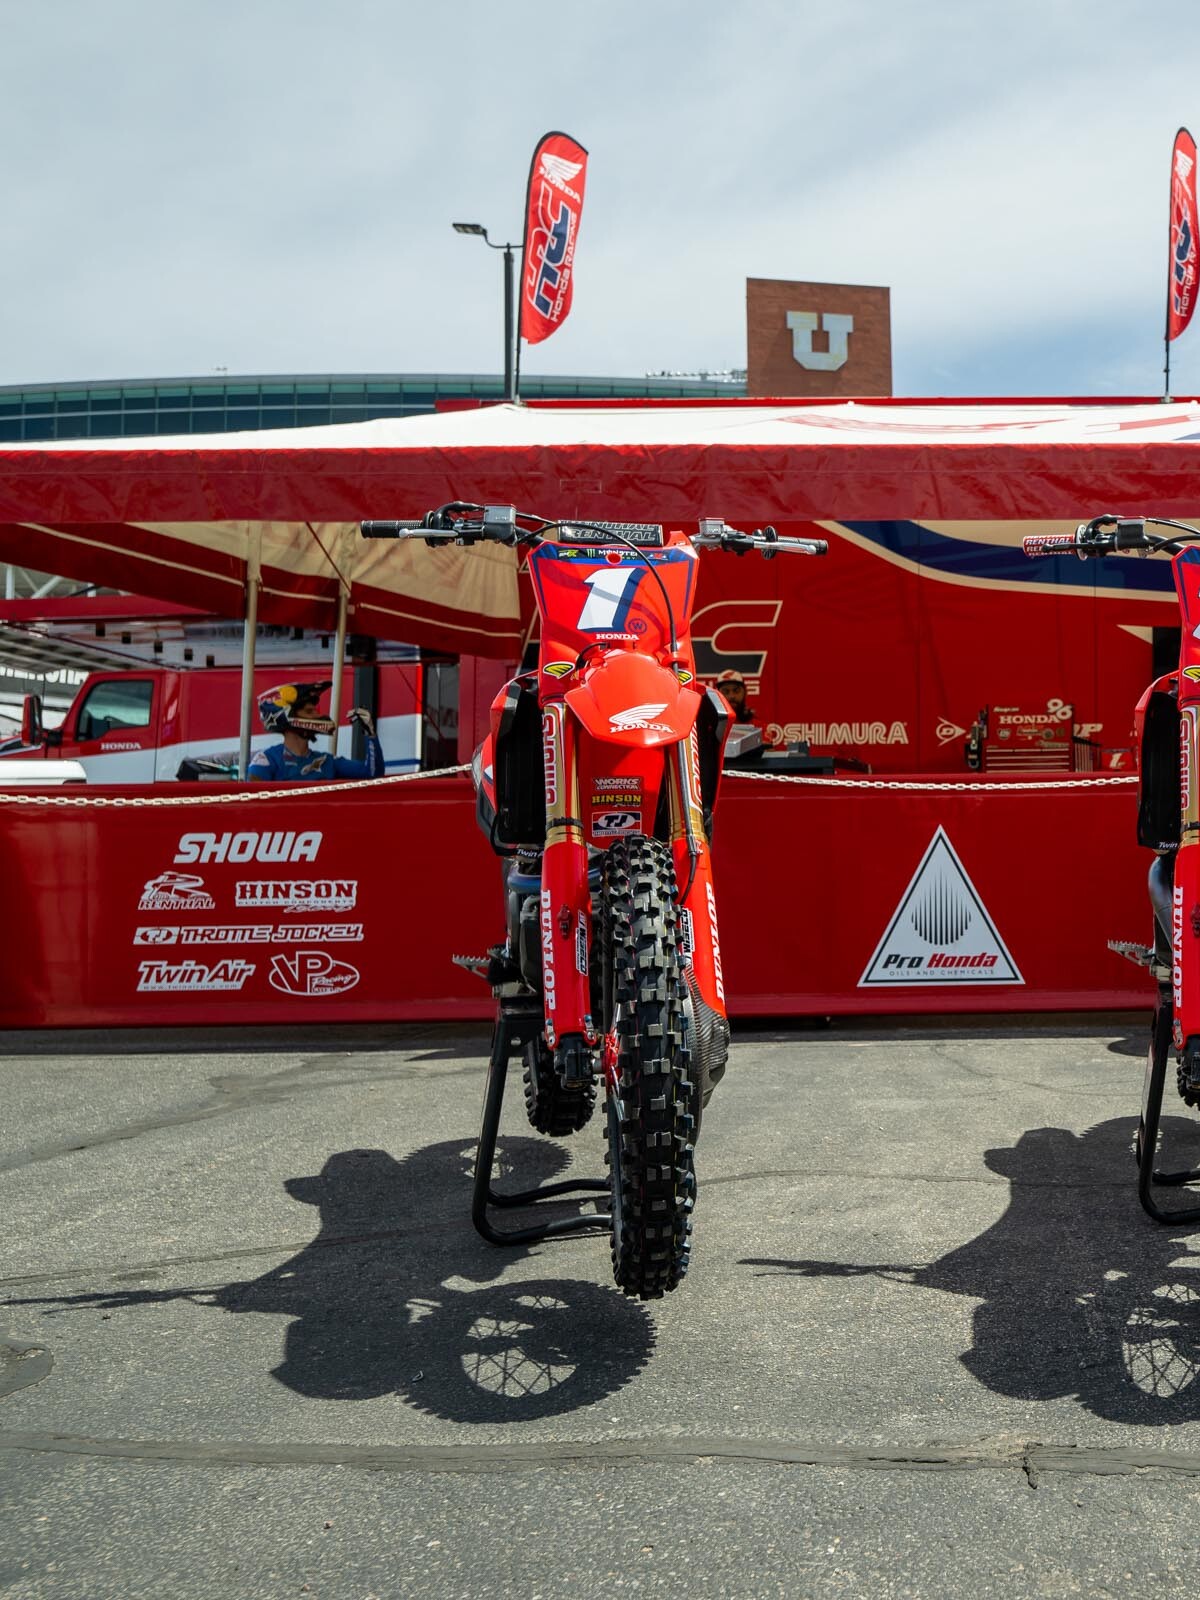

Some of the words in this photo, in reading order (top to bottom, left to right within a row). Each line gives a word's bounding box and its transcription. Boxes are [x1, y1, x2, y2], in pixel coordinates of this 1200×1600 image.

[550, 269, 571, 322] Honda
[786, 310, 854, 372] U
[577, 567, 648, 633] 1
[595, 633, 640, 641] HONDA
[999, 714, 1060, 725] HONDA
[1047, 698, 1073, 720] 96
[609, 721, 675, 734] HONDA
[767, 721, 909, 746] OSHIMURA
[101, 742, 142, 750] HONDA
[592, 794, 642, 804] HINSON
[173, 831, 323, 864] SHOWA
[237, 881, 357, 899] HINSON
[137, 898, 216, 910] RENTHAL
[272, 924, 364, 942] JOCKEY
[705, 882, 725, 1000] DUNLOP
[541, 889, 556, 1010] DUNLOP
[1173, 886, 1184, 1008] DUNLOP
[140, 961, 208, 983] Twin
[207, 960, 253, 983] Air
[882, 954, 924, 969] Pro
[926, 952, 998, 968] Honda
[271, 951, 332, 995] VP
